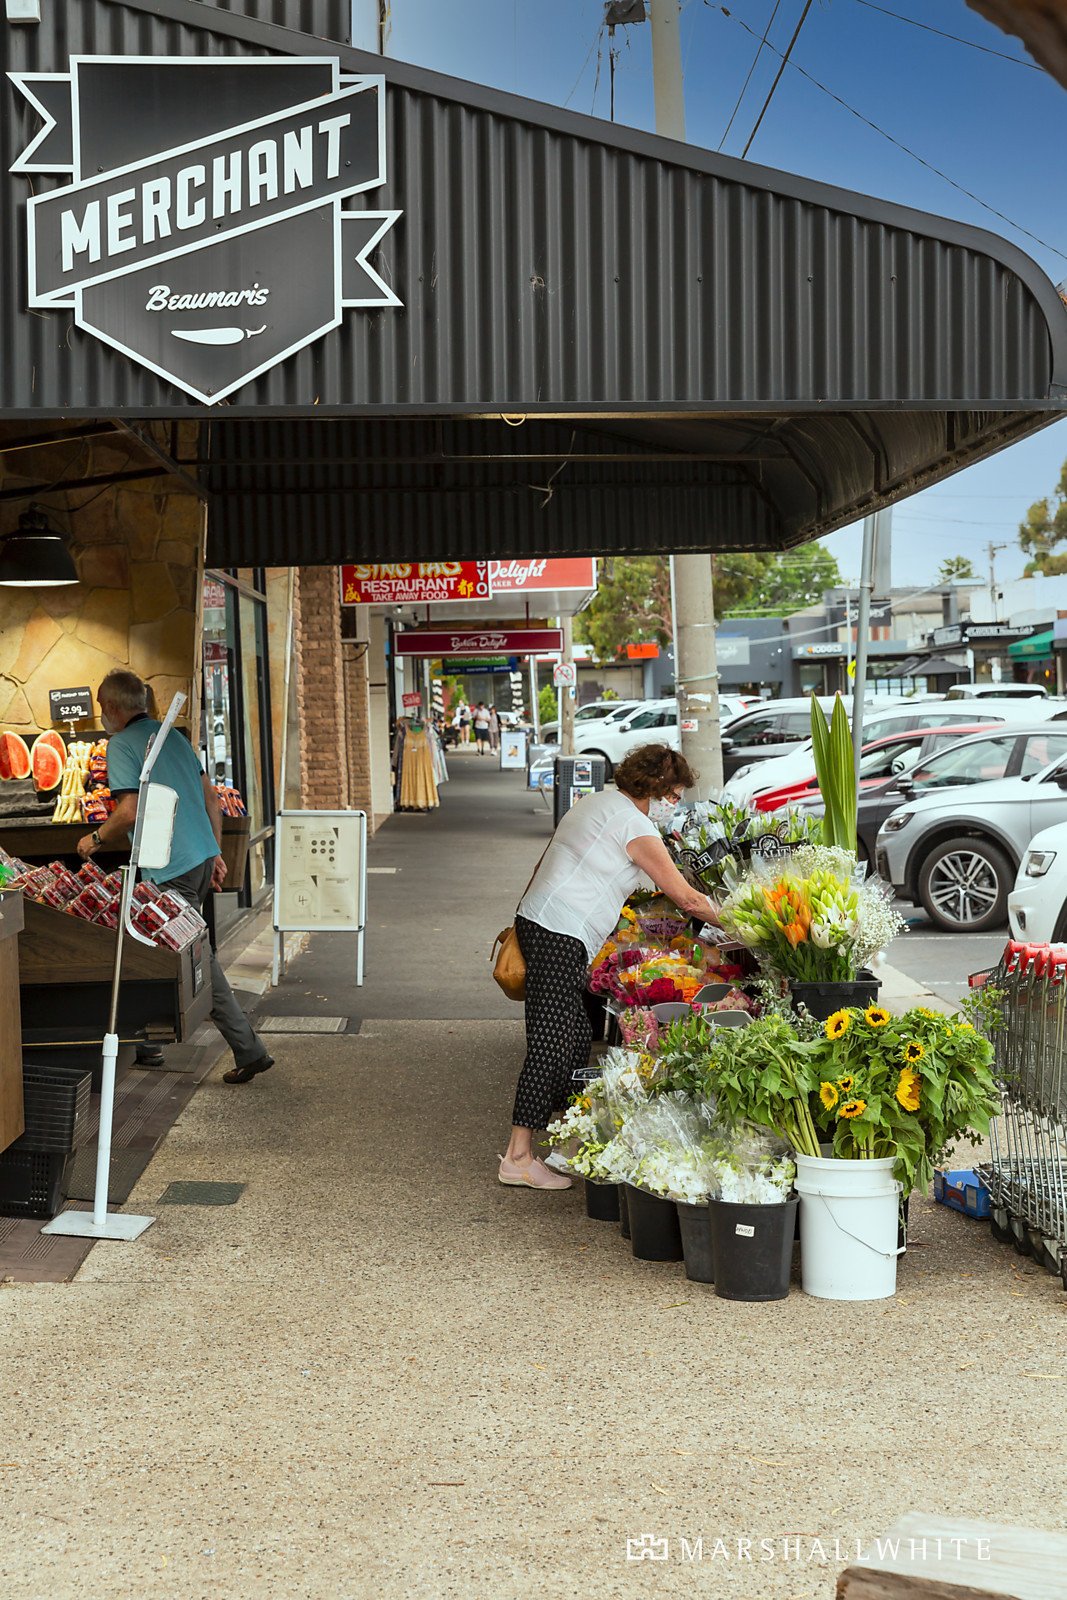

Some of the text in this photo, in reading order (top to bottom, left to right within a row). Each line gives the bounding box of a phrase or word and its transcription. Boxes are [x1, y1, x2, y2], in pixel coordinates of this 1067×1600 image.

[60, 113, 352, 273] MERCHANT
[145, 282, 270, 311] Beaumaris
[490, 559, 547, 585] Delight
[361, 577, 458, 594] RESTAURANT
[371, 590, 449, 602] TAKE AWAY FOOD
[60, 705, 83, 715] $2.99
